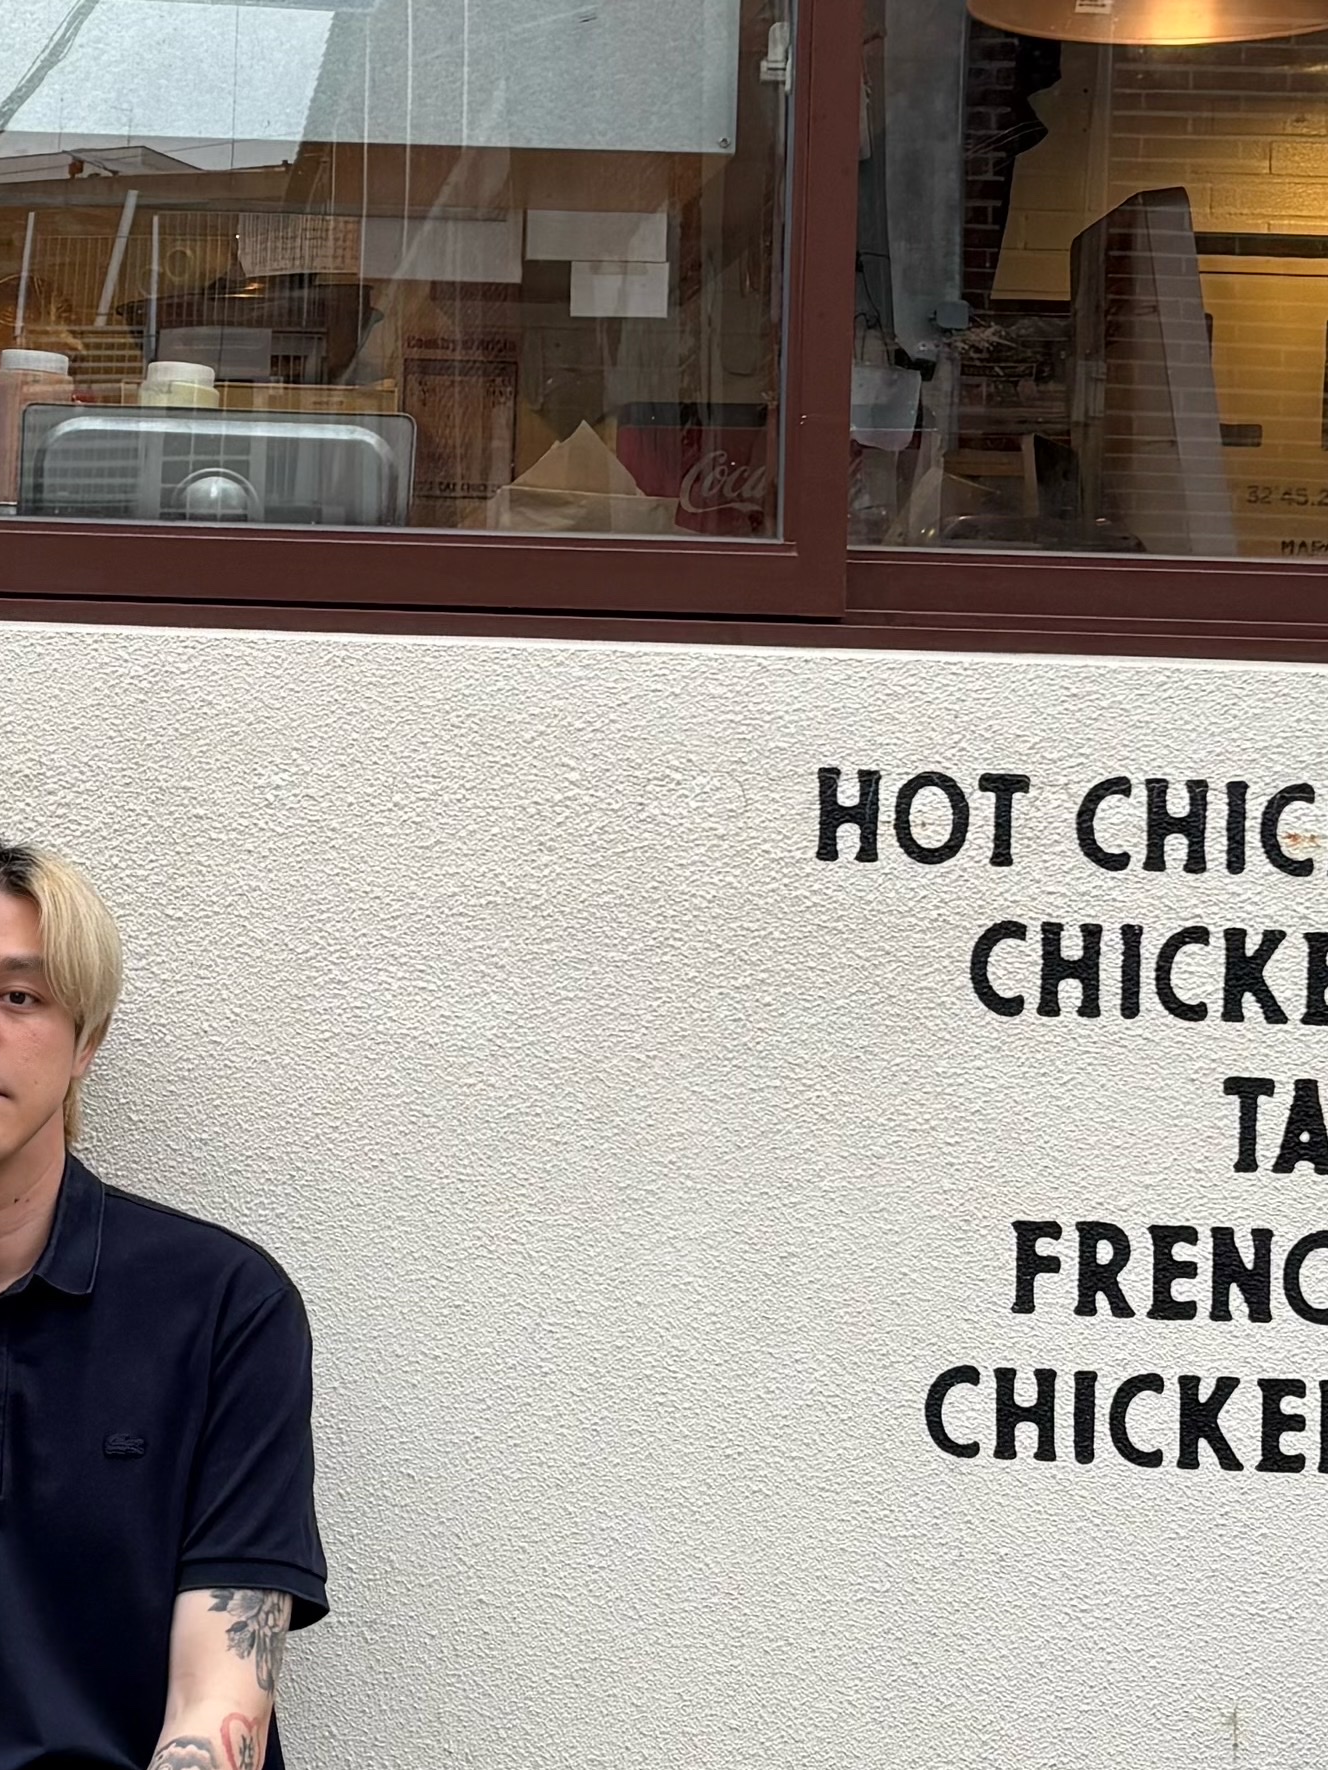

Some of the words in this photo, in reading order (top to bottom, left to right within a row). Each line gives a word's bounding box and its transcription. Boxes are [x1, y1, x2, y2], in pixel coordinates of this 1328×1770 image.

[815, 767, 1032, 867] HOT
[1075, 775, 1328, 878] CHIC
[1010, 1220, 1328, 1326] FRENC
[923, 1364, 1328, 1474] CHICKE
